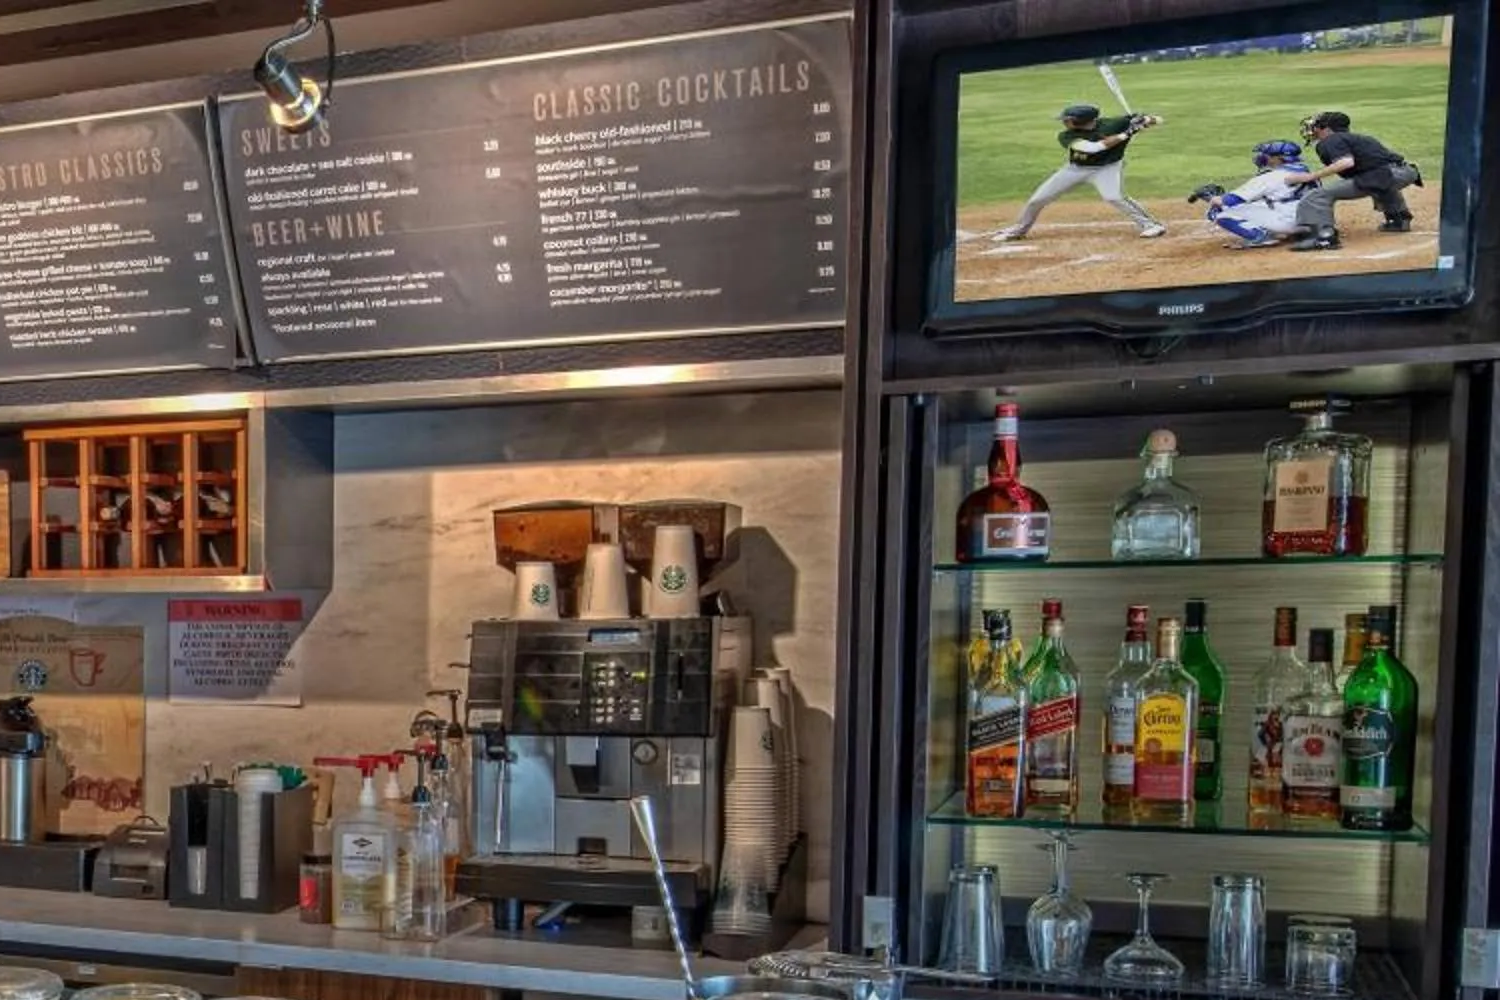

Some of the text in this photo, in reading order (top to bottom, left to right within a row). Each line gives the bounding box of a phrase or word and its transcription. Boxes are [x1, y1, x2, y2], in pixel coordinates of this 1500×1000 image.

[533, 61, 810, 121] CLASSIC COCKTAILS
[242, 119, 331, 157] SWEETS
[59, 147, 163, 184] CLASSICS
[252, 210, 385, 247] BEER+WINE
[1159, 303, 1204, 315] PHILIPS
